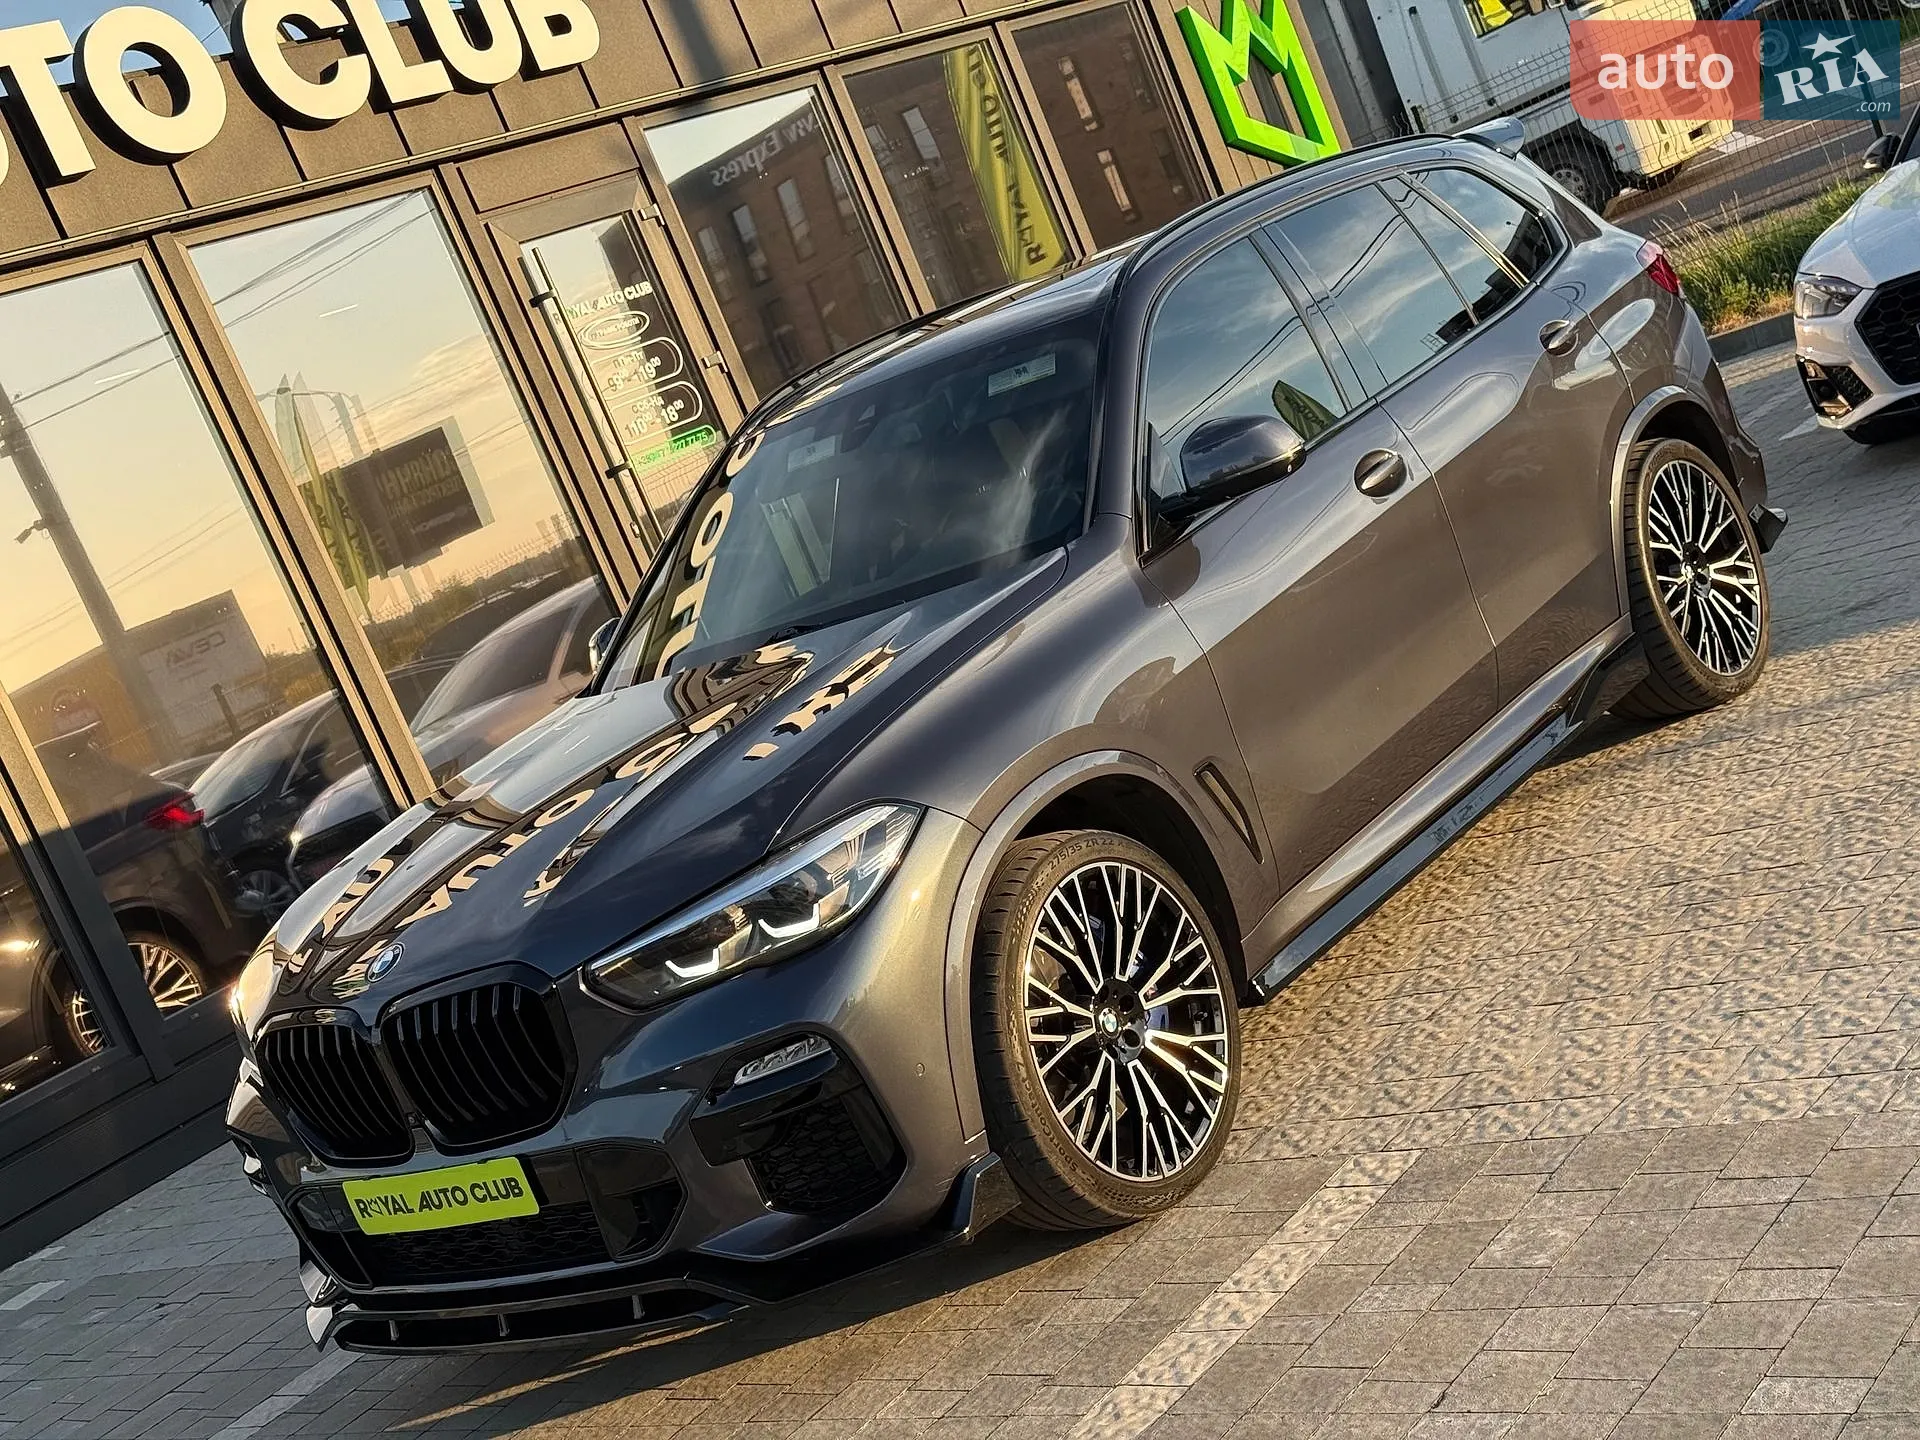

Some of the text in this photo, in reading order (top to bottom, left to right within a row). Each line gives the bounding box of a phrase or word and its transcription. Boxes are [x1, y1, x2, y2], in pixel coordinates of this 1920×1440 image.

[0, 4, 228, 190] TO
[623, 280, 653, 301] CLUB
[1048, 841, 1083, 871] 275/35
[1084, 837, 1099, 848] ZR
[418, 1185, 469, 1213] AUTO
[469, 1176, 524, 1204] CLUB
